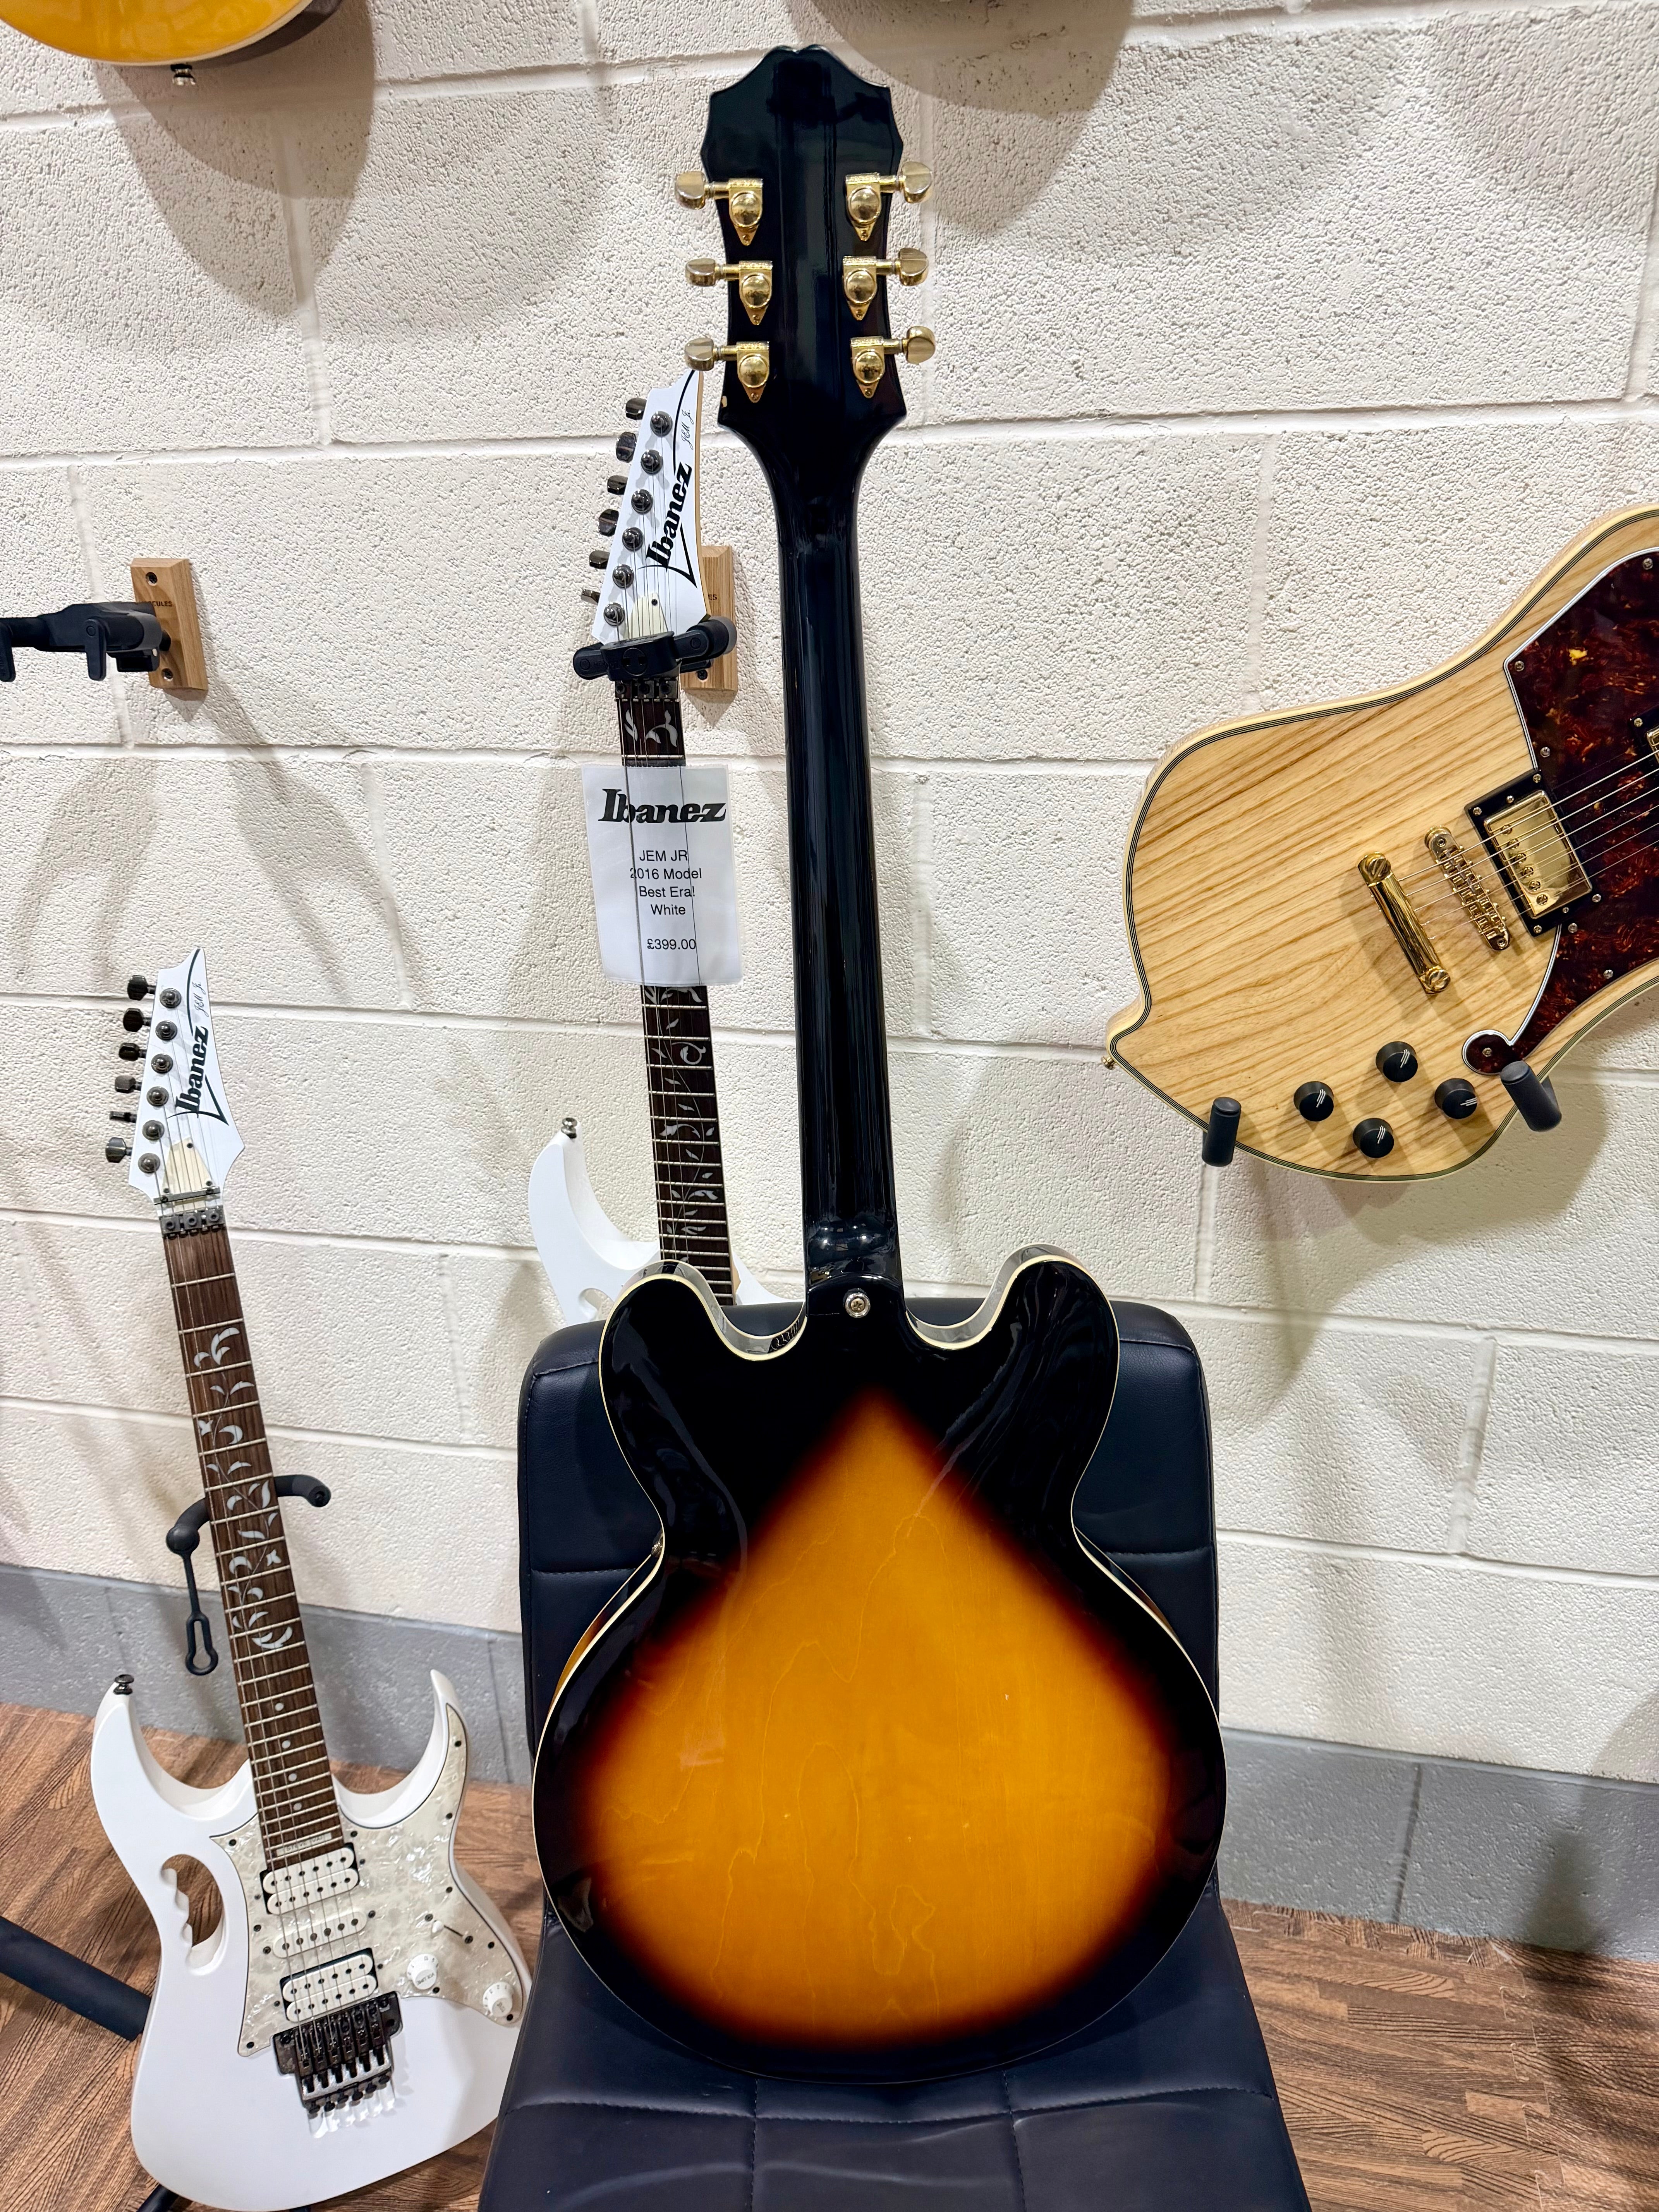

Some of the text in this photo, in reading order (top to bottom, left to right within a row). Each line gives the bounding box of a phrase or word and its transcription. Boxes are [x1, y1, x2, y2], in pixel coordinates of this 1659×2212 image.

[646, 461, 692, 573] Ibanez
[598, 788, 726, 824] Ibanez
[639, 849, 688, 862] JEM JR
[630, 867, 702, 879] 2016 Model
[639, 886, 696, 897] Best Era!
[650, 904, 686, 915] White
[647, 938, 697, 950] £399.00
[175, 1025, 209, 1119] Ibanez
